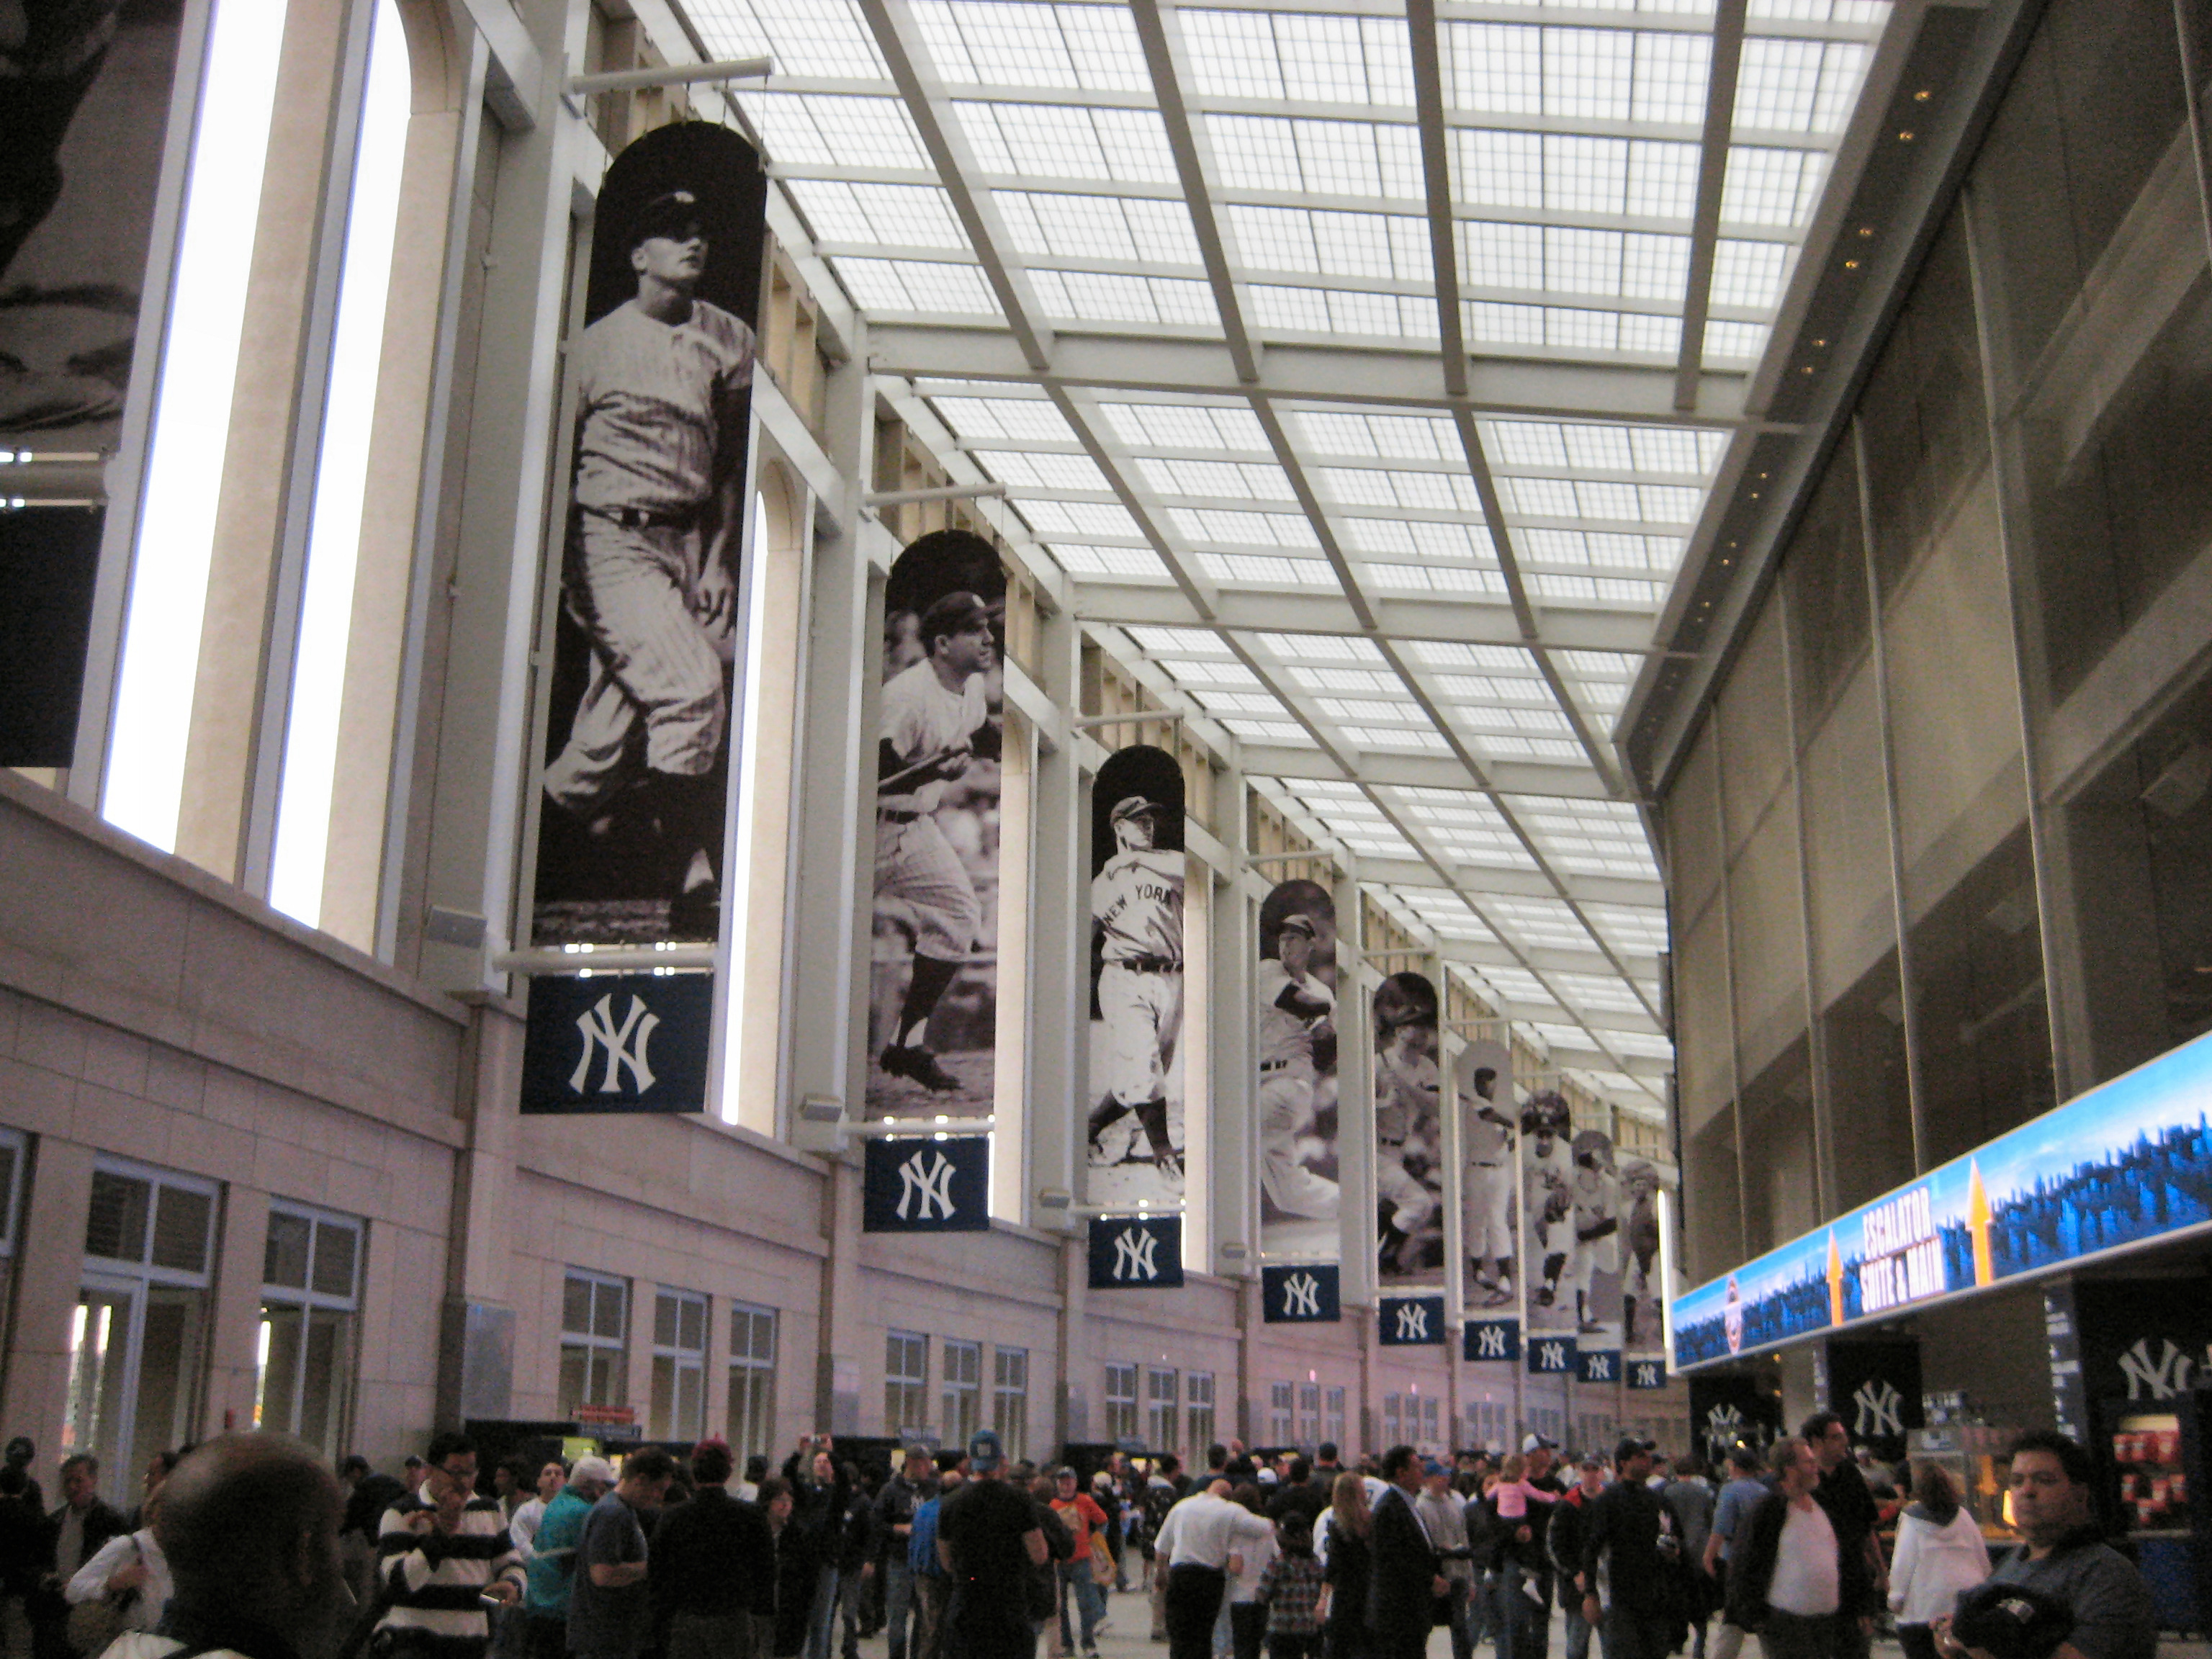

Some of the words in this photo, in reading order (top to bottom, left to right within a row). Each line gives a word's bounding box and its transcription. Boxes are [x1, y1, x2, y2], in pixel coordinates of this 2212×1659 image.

[1102, 894, 1127, 927] NEW
[569, 992, 660, 1094] NY
[896, 1150, 956, 1220] NY
[1862, 1187, 1933, 1261] ESCALATOR
[1113, 1228, 1158, 1280] NY
[1860, 1256, 1896, 1313] SUITE
[1895, 1258, 1907, 1303] &
[1906, 1237, 1946, 1300] MAIN
[1283, 1272, 1320, 1316] NY
[1396, 1303, 1429, 1339] NY
[1478, 1325, 1506, 1357] NY
[1541, 1341, 1565, 1370] NY
[1588, 1354, 1610, 1379] NY
[2118, 1337, 2193, 1401] NY
[1853, 1380, 1905, 1437] NY
